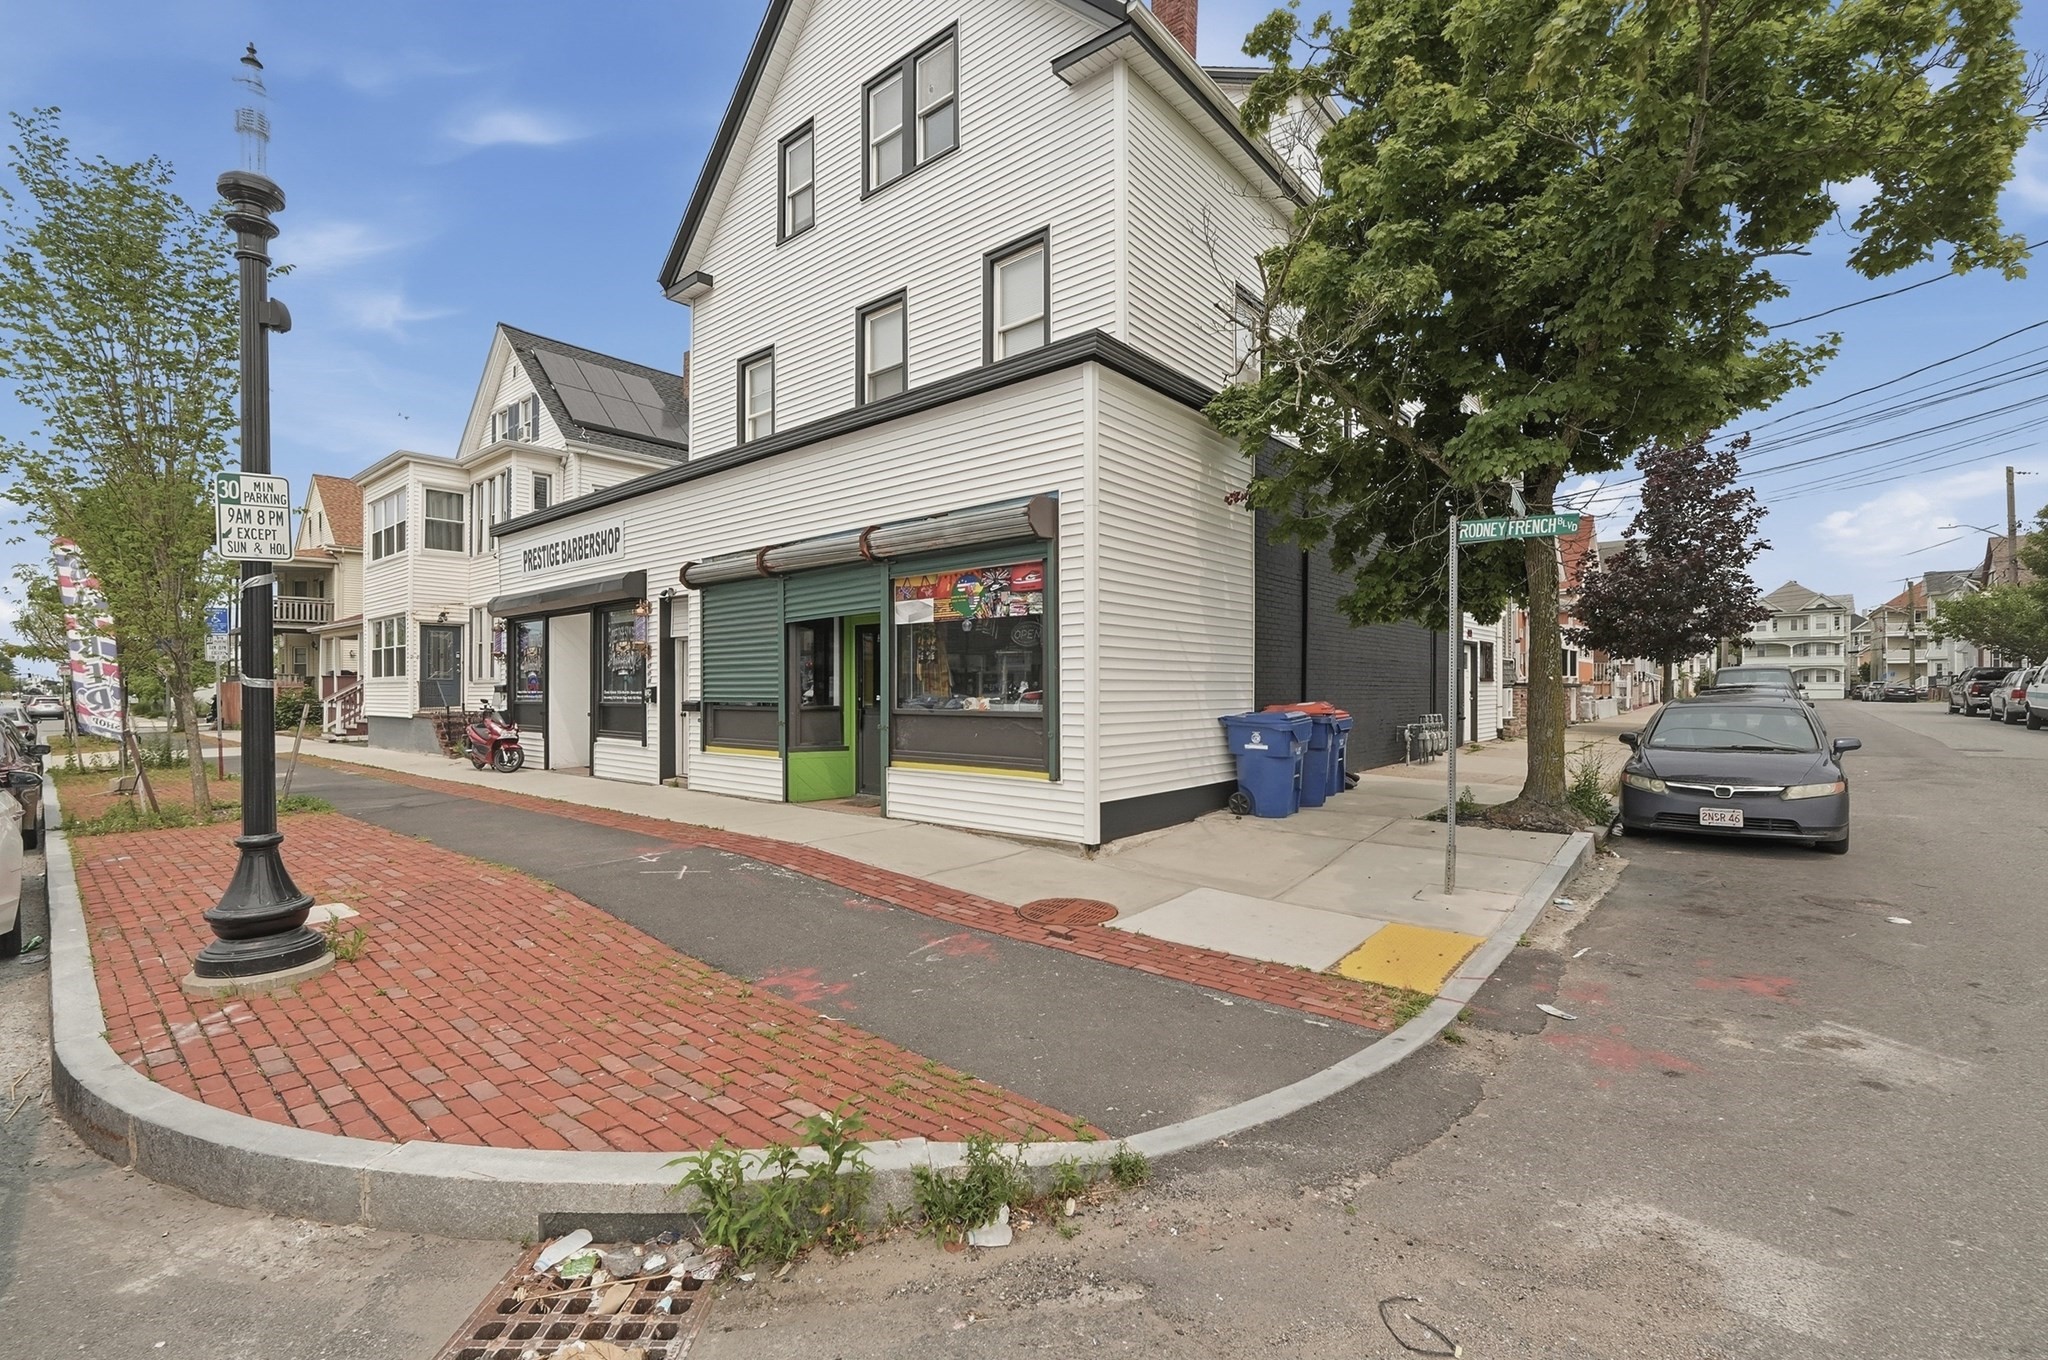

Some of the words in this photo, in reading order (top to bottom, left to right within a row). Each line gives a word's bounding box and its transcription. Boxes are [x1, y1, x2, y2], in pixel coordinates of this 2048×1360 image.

[218, 479, 240, 499] 30
[253, 481, 274, 493] MIN
[243, 491, 287, 505] PARKING
[227, 507, 252, 524] 9AM
[237, 527, 277, 541] EXCEPT
[1459, 521, 1507, 539] RODNEY
[1508, 517, 1557, 536] FRENCH
[1557, 516, 1578, 532] BLVD
[227, 540, 247, 553] SUN
[253, 542, 263, 554] &
[269, 543, 288, 555] HOL
[523, 542, 560, 572] PRESTIGE
[561, 527, 621, 564] BARBERSHOP
[1013, 628, 1041, 641] OPEN
[1728, 813, 1741, 824] 46
